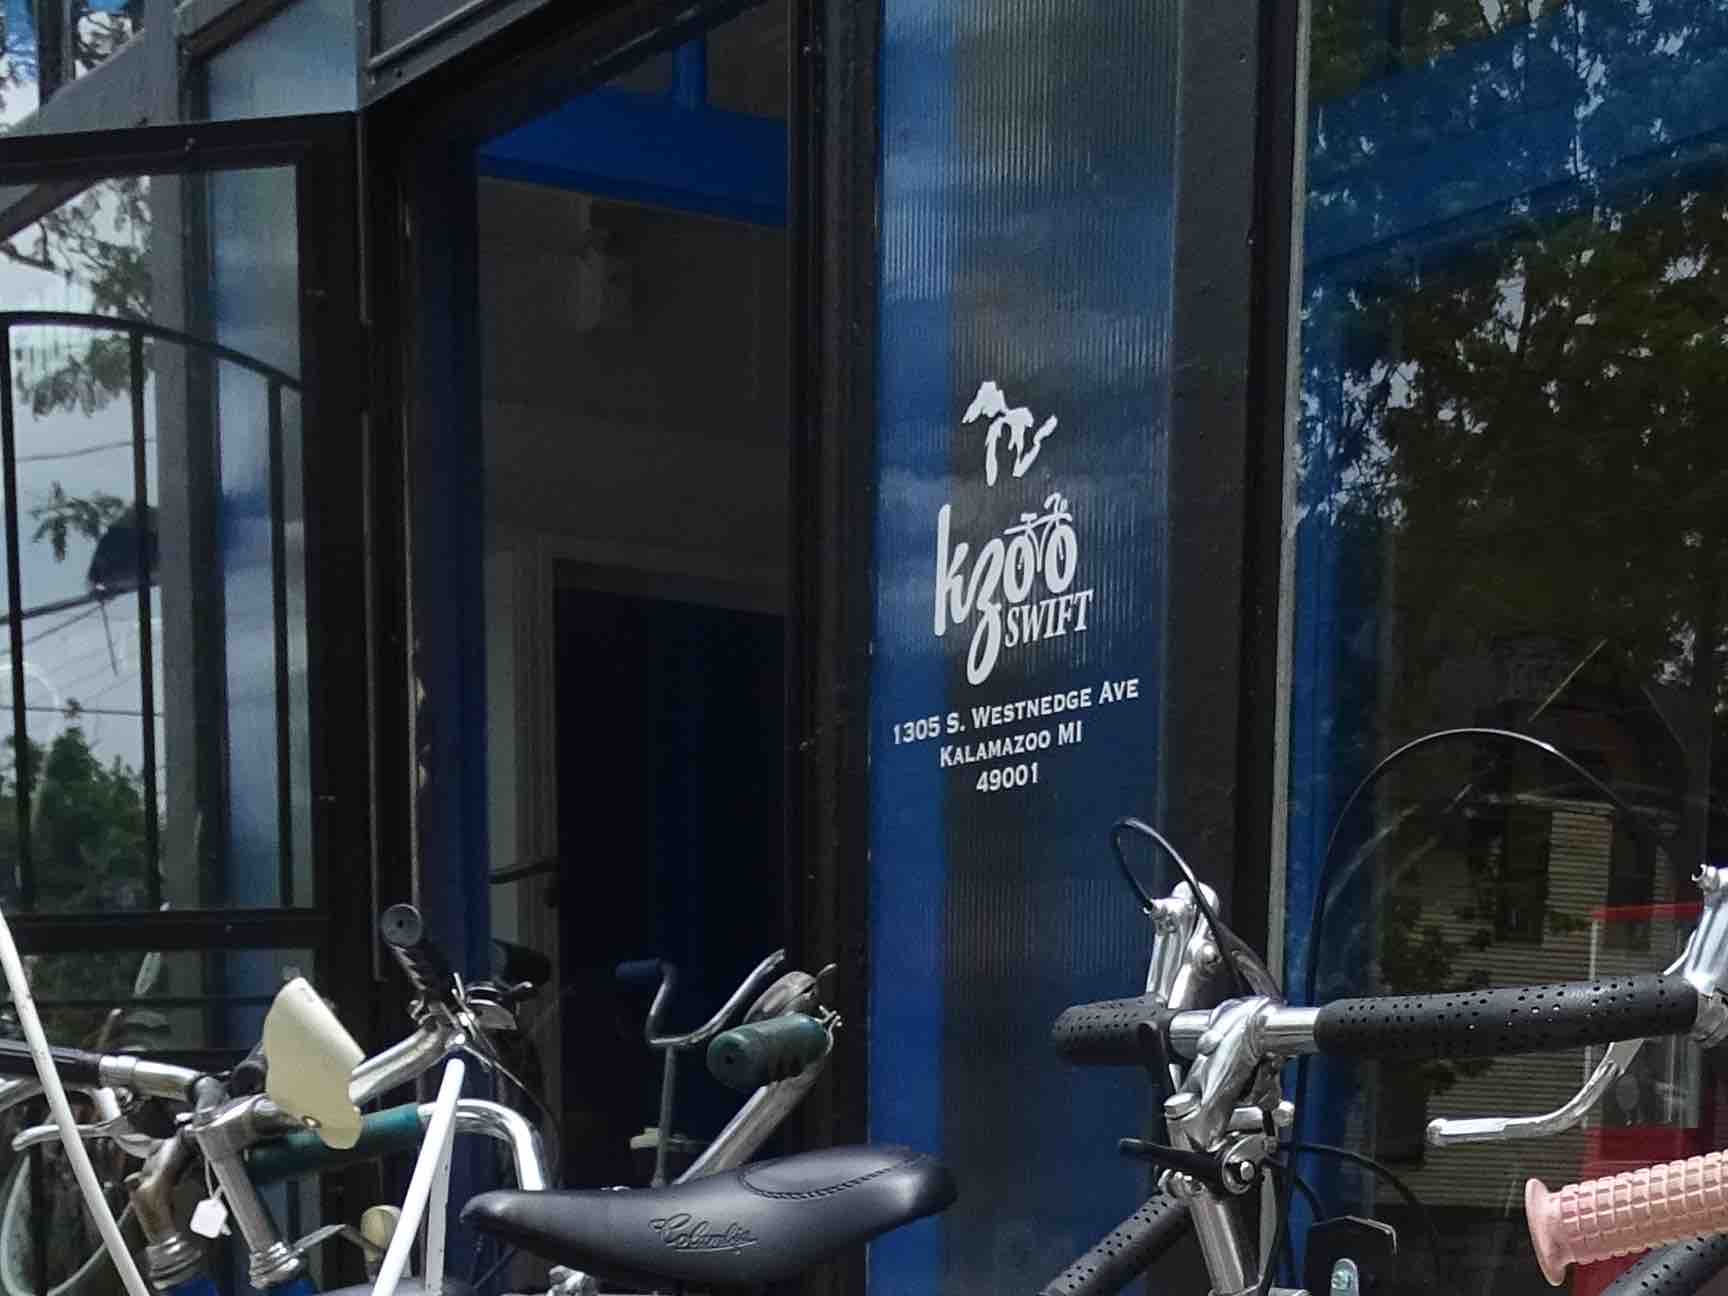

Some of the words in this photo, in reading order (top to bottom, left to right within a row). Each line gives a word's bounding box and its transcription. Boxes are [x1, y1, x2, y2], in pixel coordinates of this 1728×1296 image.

[1004, 589, 1094, 650] SWIFT
[893, 714, 941, 746] 1305
[945, 711, 966, 736] S.
[1058, 720, 1083, 746] MI
[975, 761, 1040, 794] 49001
